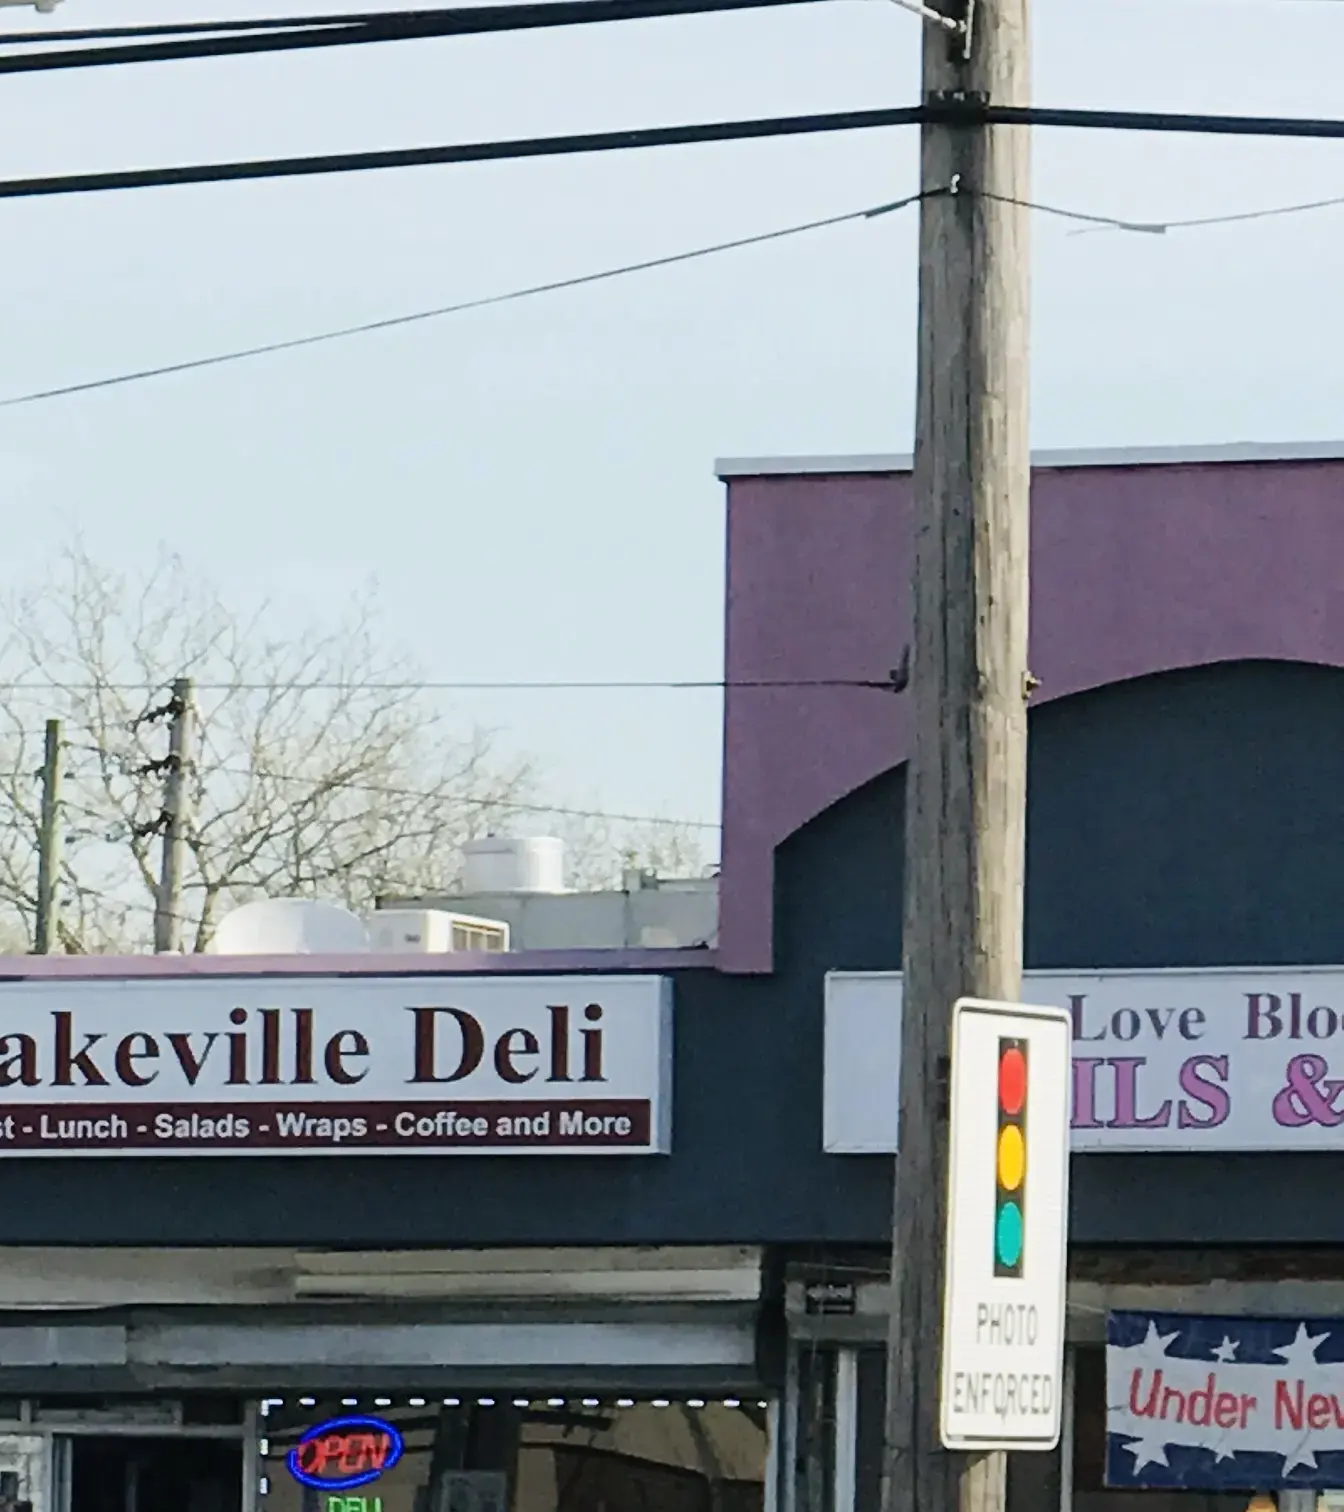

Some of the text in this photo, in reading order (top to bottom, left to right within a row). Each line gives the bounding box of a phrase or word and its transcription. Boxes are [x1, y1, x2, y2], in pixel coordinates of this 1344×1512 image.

[1068, 992, 1344, 1041] Love Blo
[404, 1003, 608, 1084] Deli
[1070, 1053, 1344, 1129] ILS &
[40, 1114, 128, 1139] Lunch
[154, 1113, 250, 1138] Salads
[276, 1112, 367, 1141] Wraps
[394, 1111, 488, 1136] Coffee
[496, 1111, 549, 1136] and
[559, 1110, 631, 1136] More
[977, 1302, 1040, 1346] PHOTO
[953, 1371, 1052, 1418] ENFORCED
[1129, 1367, 1257, 1430] Under
[296, 1433, 390, 1474] OPEN
